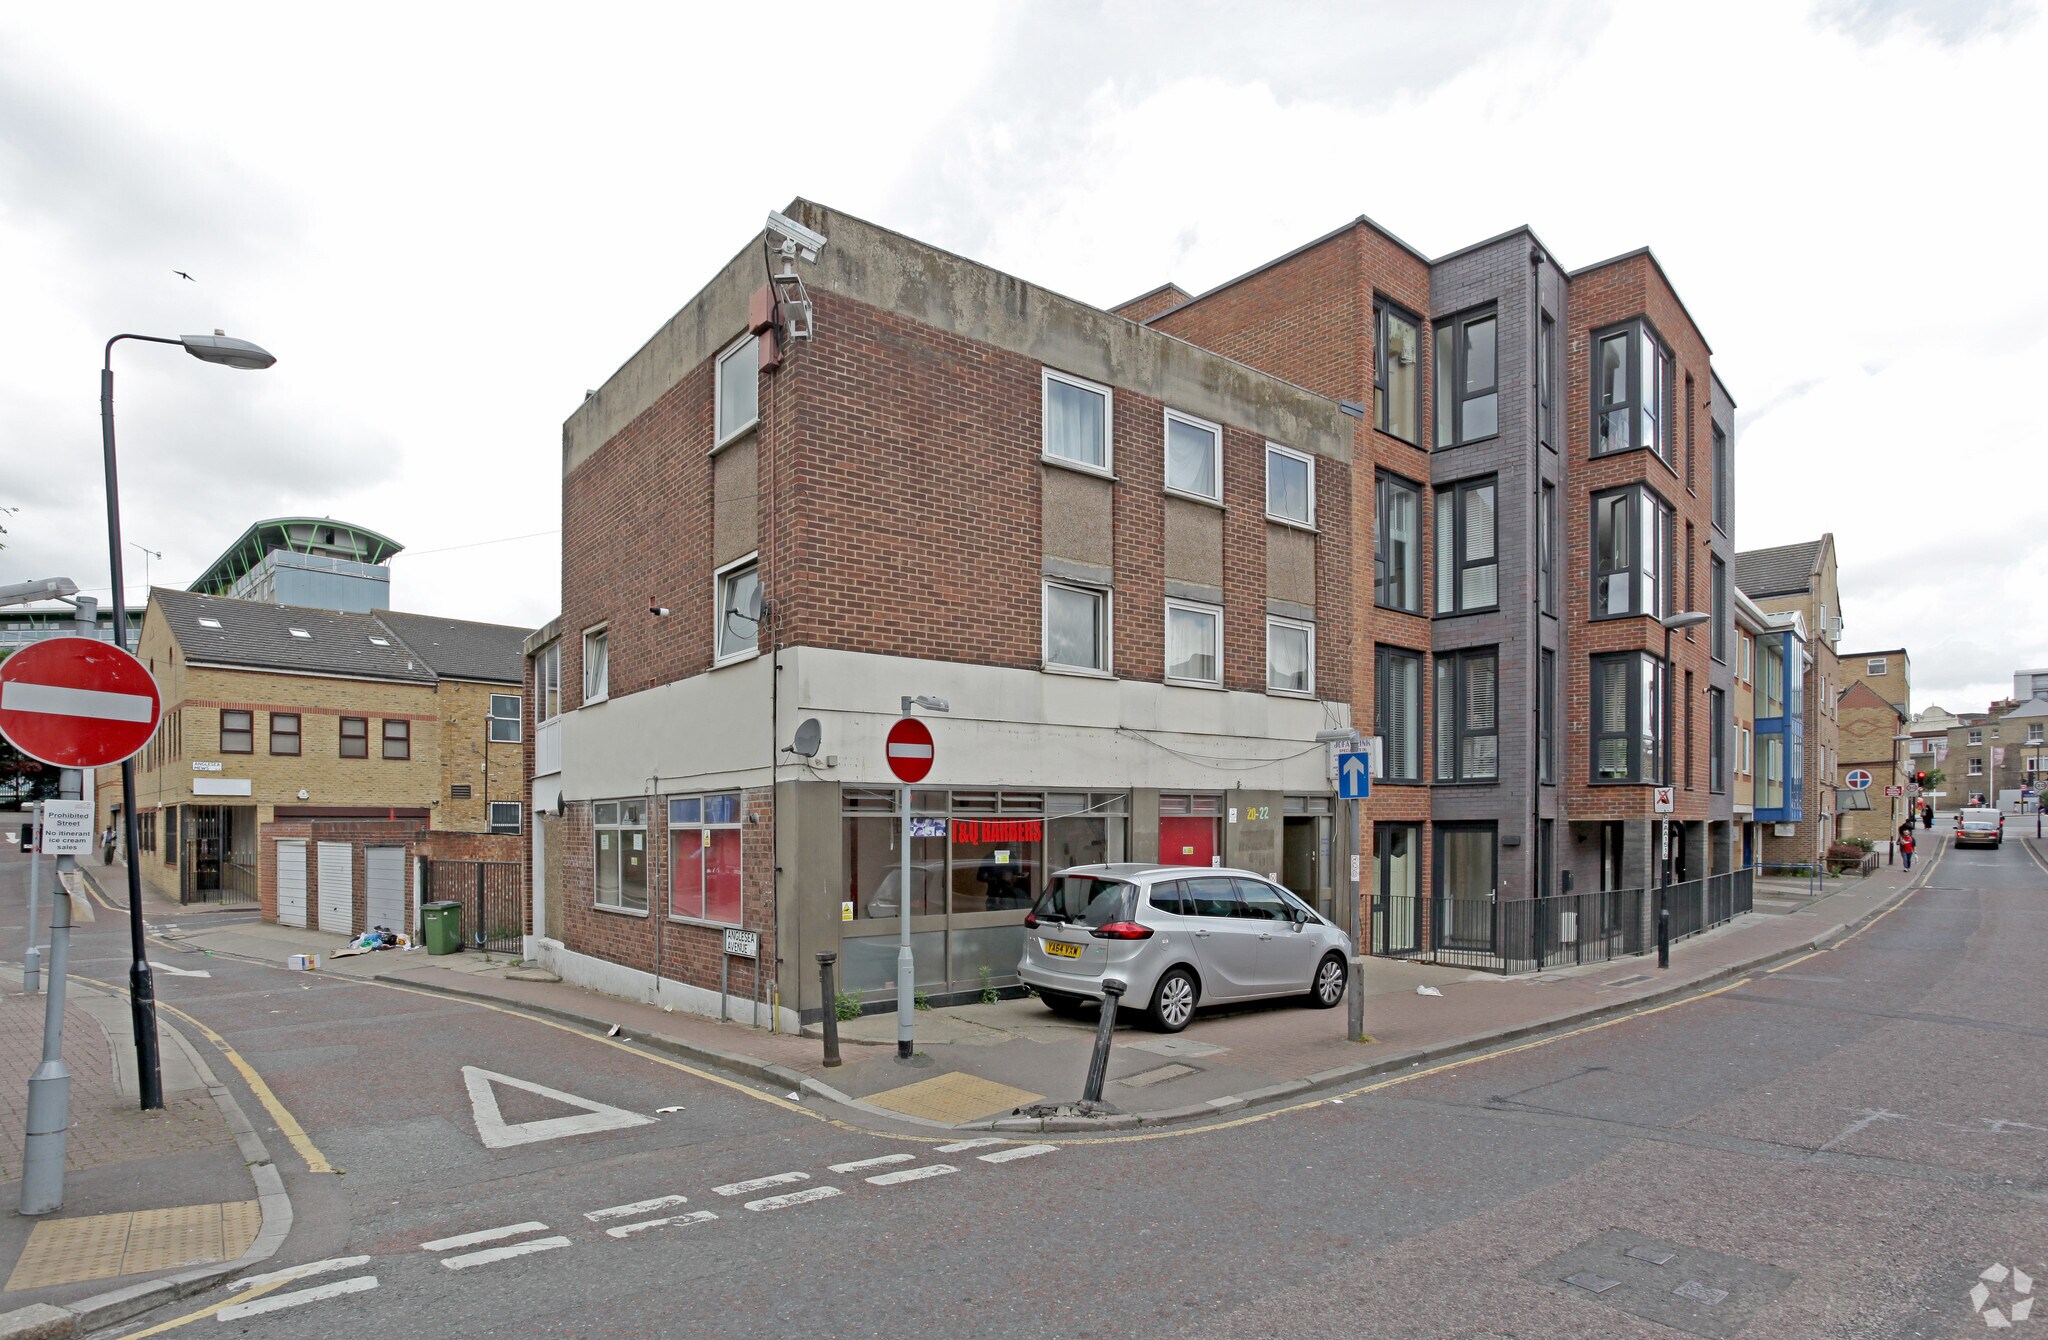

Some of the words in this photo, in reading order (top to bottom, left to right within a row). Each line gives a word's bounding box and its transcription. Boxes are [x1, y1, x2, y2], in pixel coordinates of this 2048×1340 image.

[48, 811, 89, 819] Prohibited
[981, 817, 1043, 843] BARBERS
[728, 930, 755, 943] ANGLESEA
[728, 941, 748, 954] AVENUE
